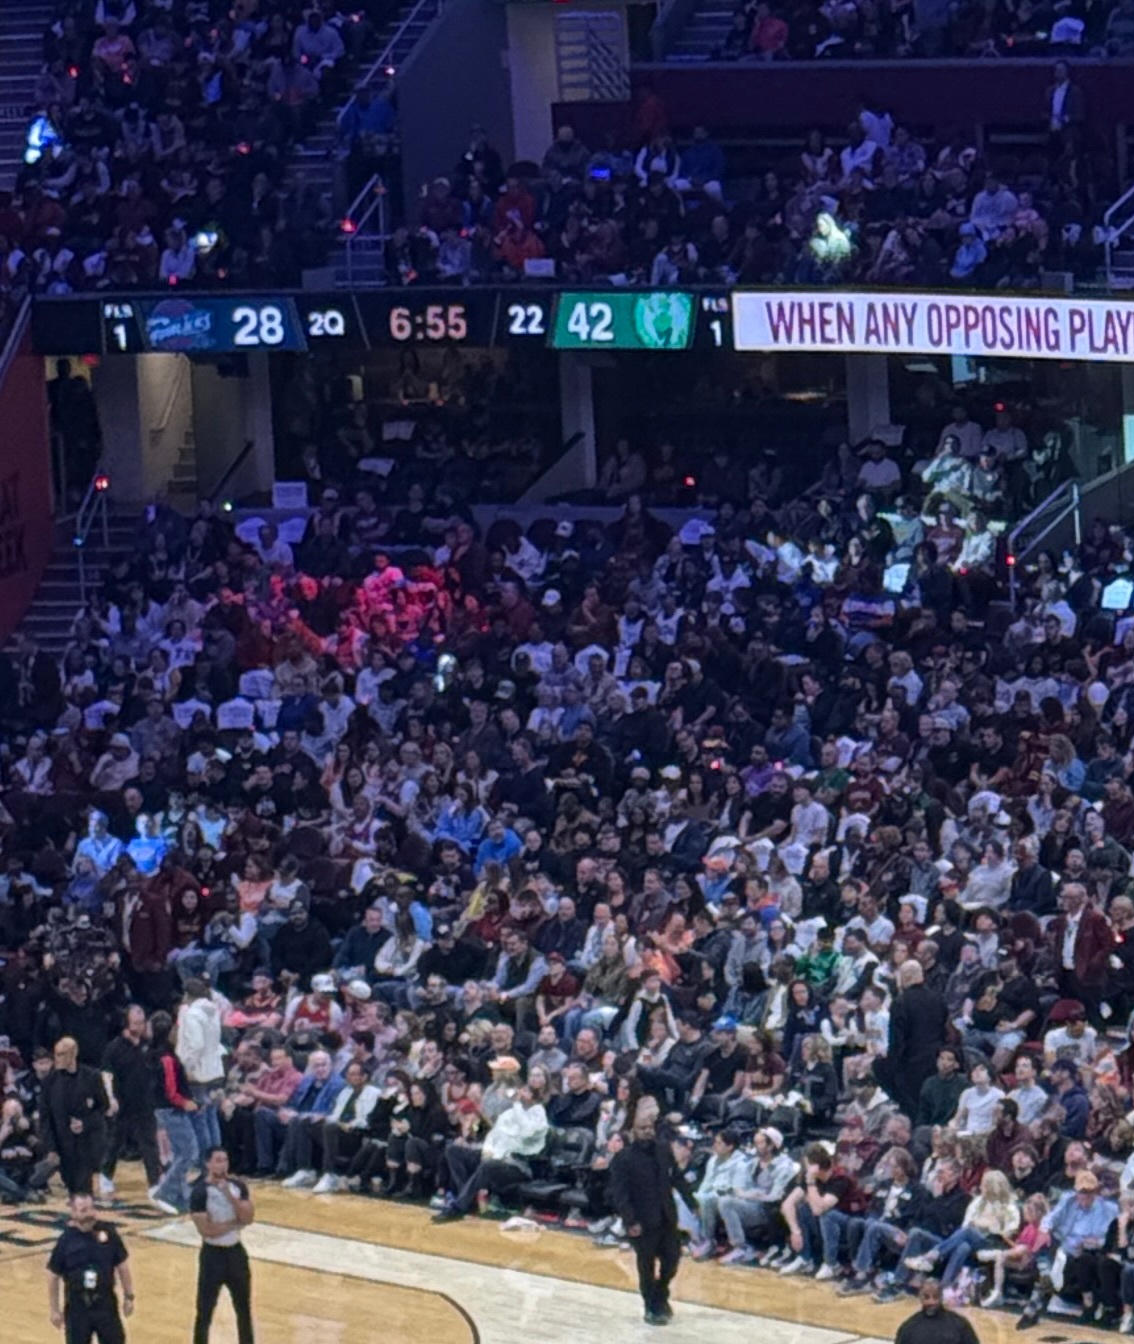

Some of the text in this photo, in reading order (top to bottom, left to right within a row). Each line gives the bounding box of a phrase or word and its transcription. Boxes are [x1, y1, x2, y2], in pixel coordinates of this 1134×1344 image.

[233, 308, 285, 345] 28
[309, 311, 344, 337] 2Q
[389, 306, 466, 339] 6:55
[509, 306, 545, 334] 22
[568, 304, 613, 340] 42
[711, 320, 722, 346] 1
[767, 300, 855, 346] WHEN
[864, 303, 916, 346] ANY
[927, 305, 1059, 352] OPPOSING
[113, 325, 127, 351] 1
